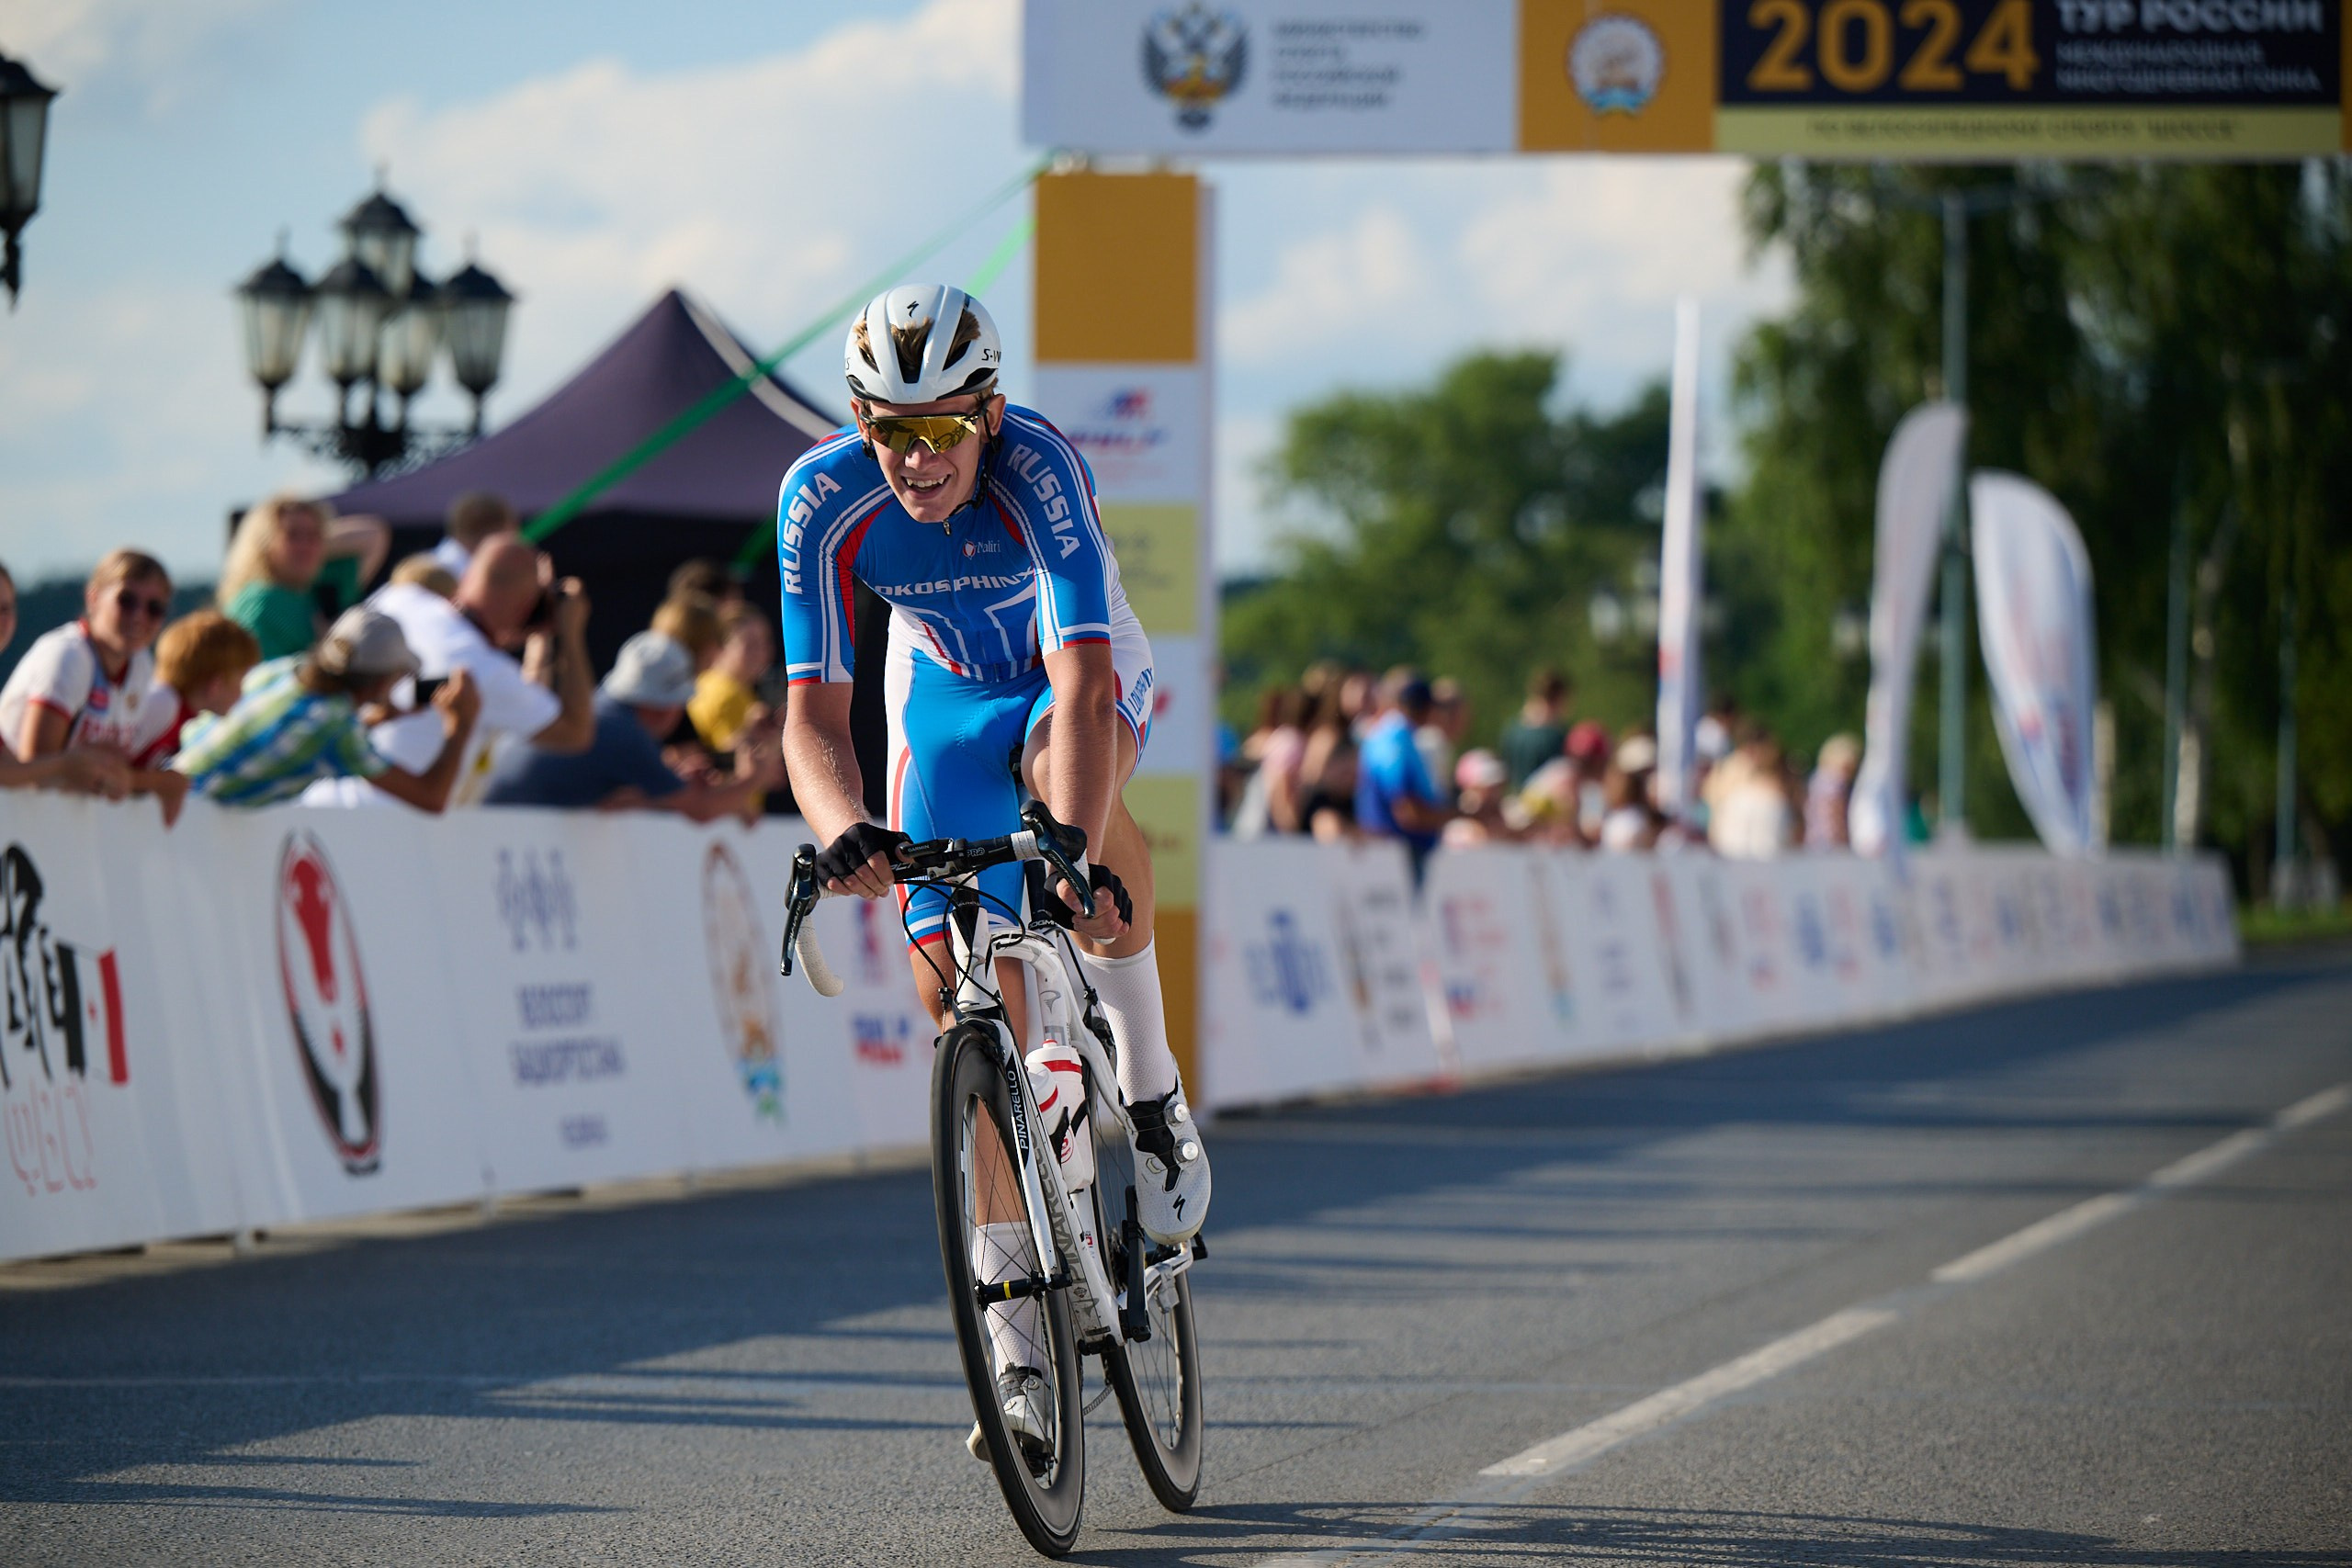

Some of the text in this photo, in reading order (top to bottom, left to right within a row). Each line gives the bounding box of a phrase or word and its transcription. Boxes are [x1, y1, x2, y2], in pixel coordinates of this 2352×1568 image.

[1748, 0, 2040, 91] 2024
[783, 471, 842, 595] RUSSIA
[1007, 442, 1080, 560] RUSSIA
[875, 566, 1034, 596] OKOSPHINX
[1007, 1070, 1029, 1150] PINARELLO
